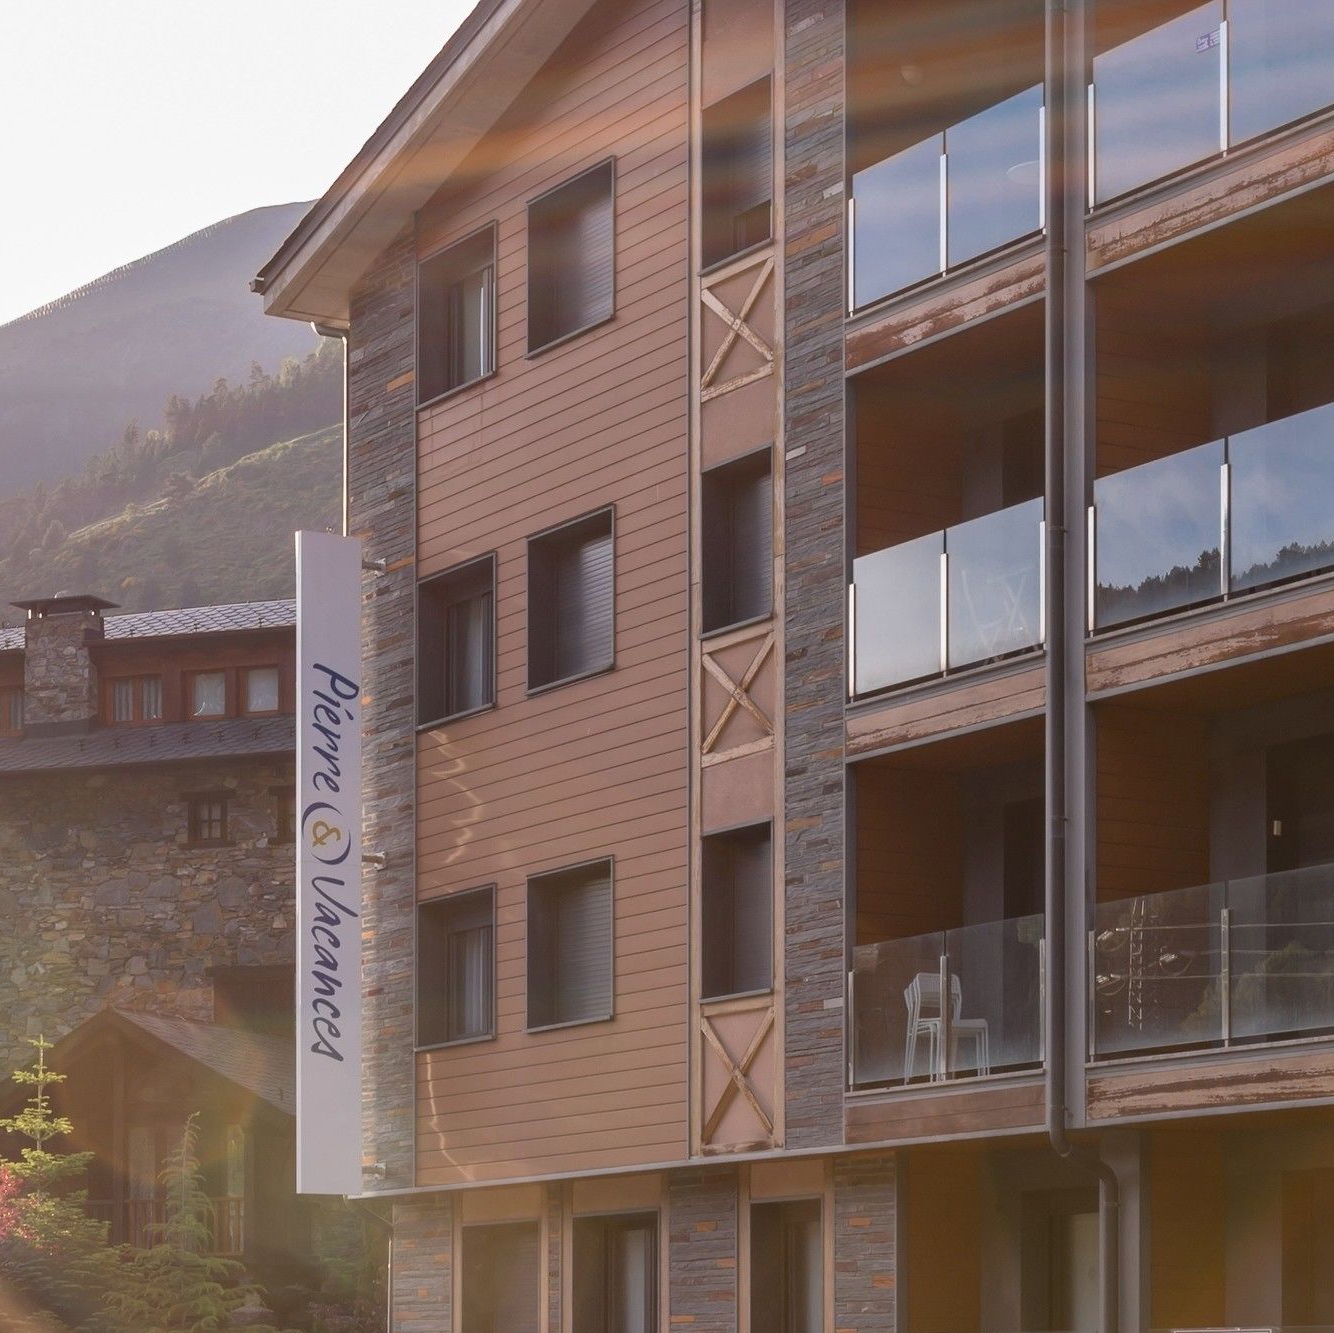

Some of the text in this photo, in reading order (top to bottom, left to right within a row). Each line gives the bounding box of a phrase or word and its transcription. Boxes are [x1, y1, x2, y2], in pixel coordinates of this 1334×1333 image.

[310, 662, 360, 1063] Pierre & Vacances
